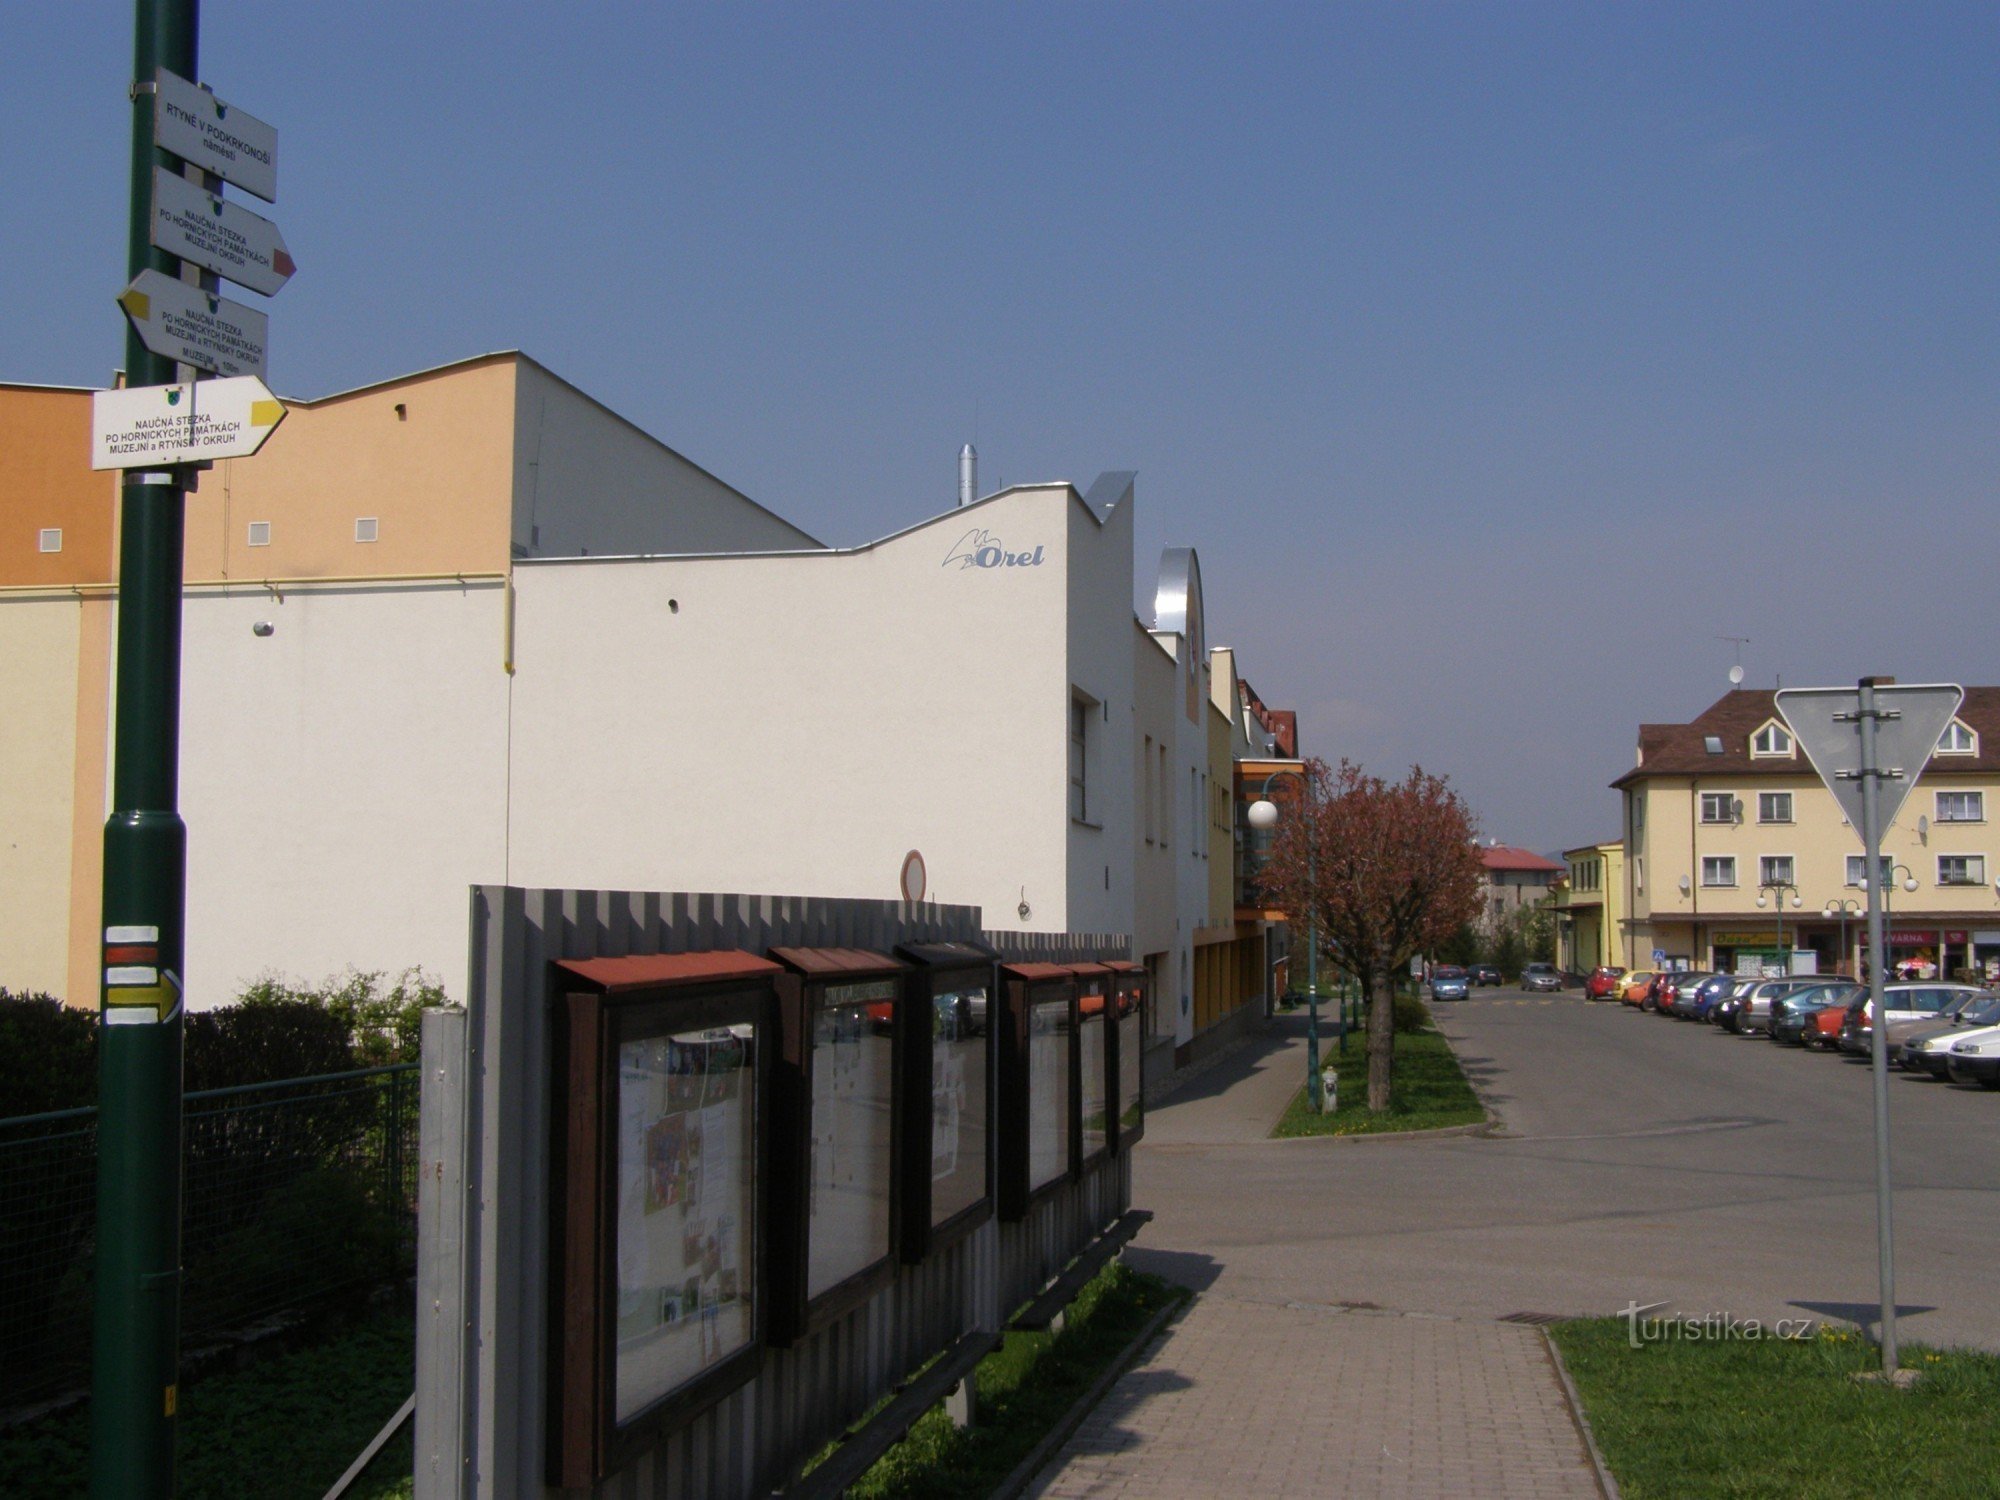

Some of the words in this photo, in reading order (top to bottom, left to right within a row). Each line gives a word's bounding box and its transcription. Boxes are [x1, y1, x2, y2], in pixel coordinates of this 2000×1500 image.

[199, 119, 206, 131] V
[207, 124, 271, 166] PODKRKONOŠÍ
[160, 209, 170, 221] PO
[219, 225, 247, 245] STEZKA
[219, 248, 245, 268] OKRUH
[162, 311, 173, 323] PO
[216, 320, 243, 337] STEZKA
[182, 347, 214, 364] MUZEUM
[236, 349, 260, 365] OKRUH
[136, 415, 174, 430] NAUČNÁ
[176, 413, 211, 426] STEZKA
[106, 434, 119, 443] PO
[121, 427, 181, 442] HORNICKÝCH
[184, 420, 240, 436] PAMÁTKÁCH
[110, 442, 149, 454] MUZEJNÍ
[203, 434, 236, 446] OKRUH
[975, 545, 1044, 568] Orel
